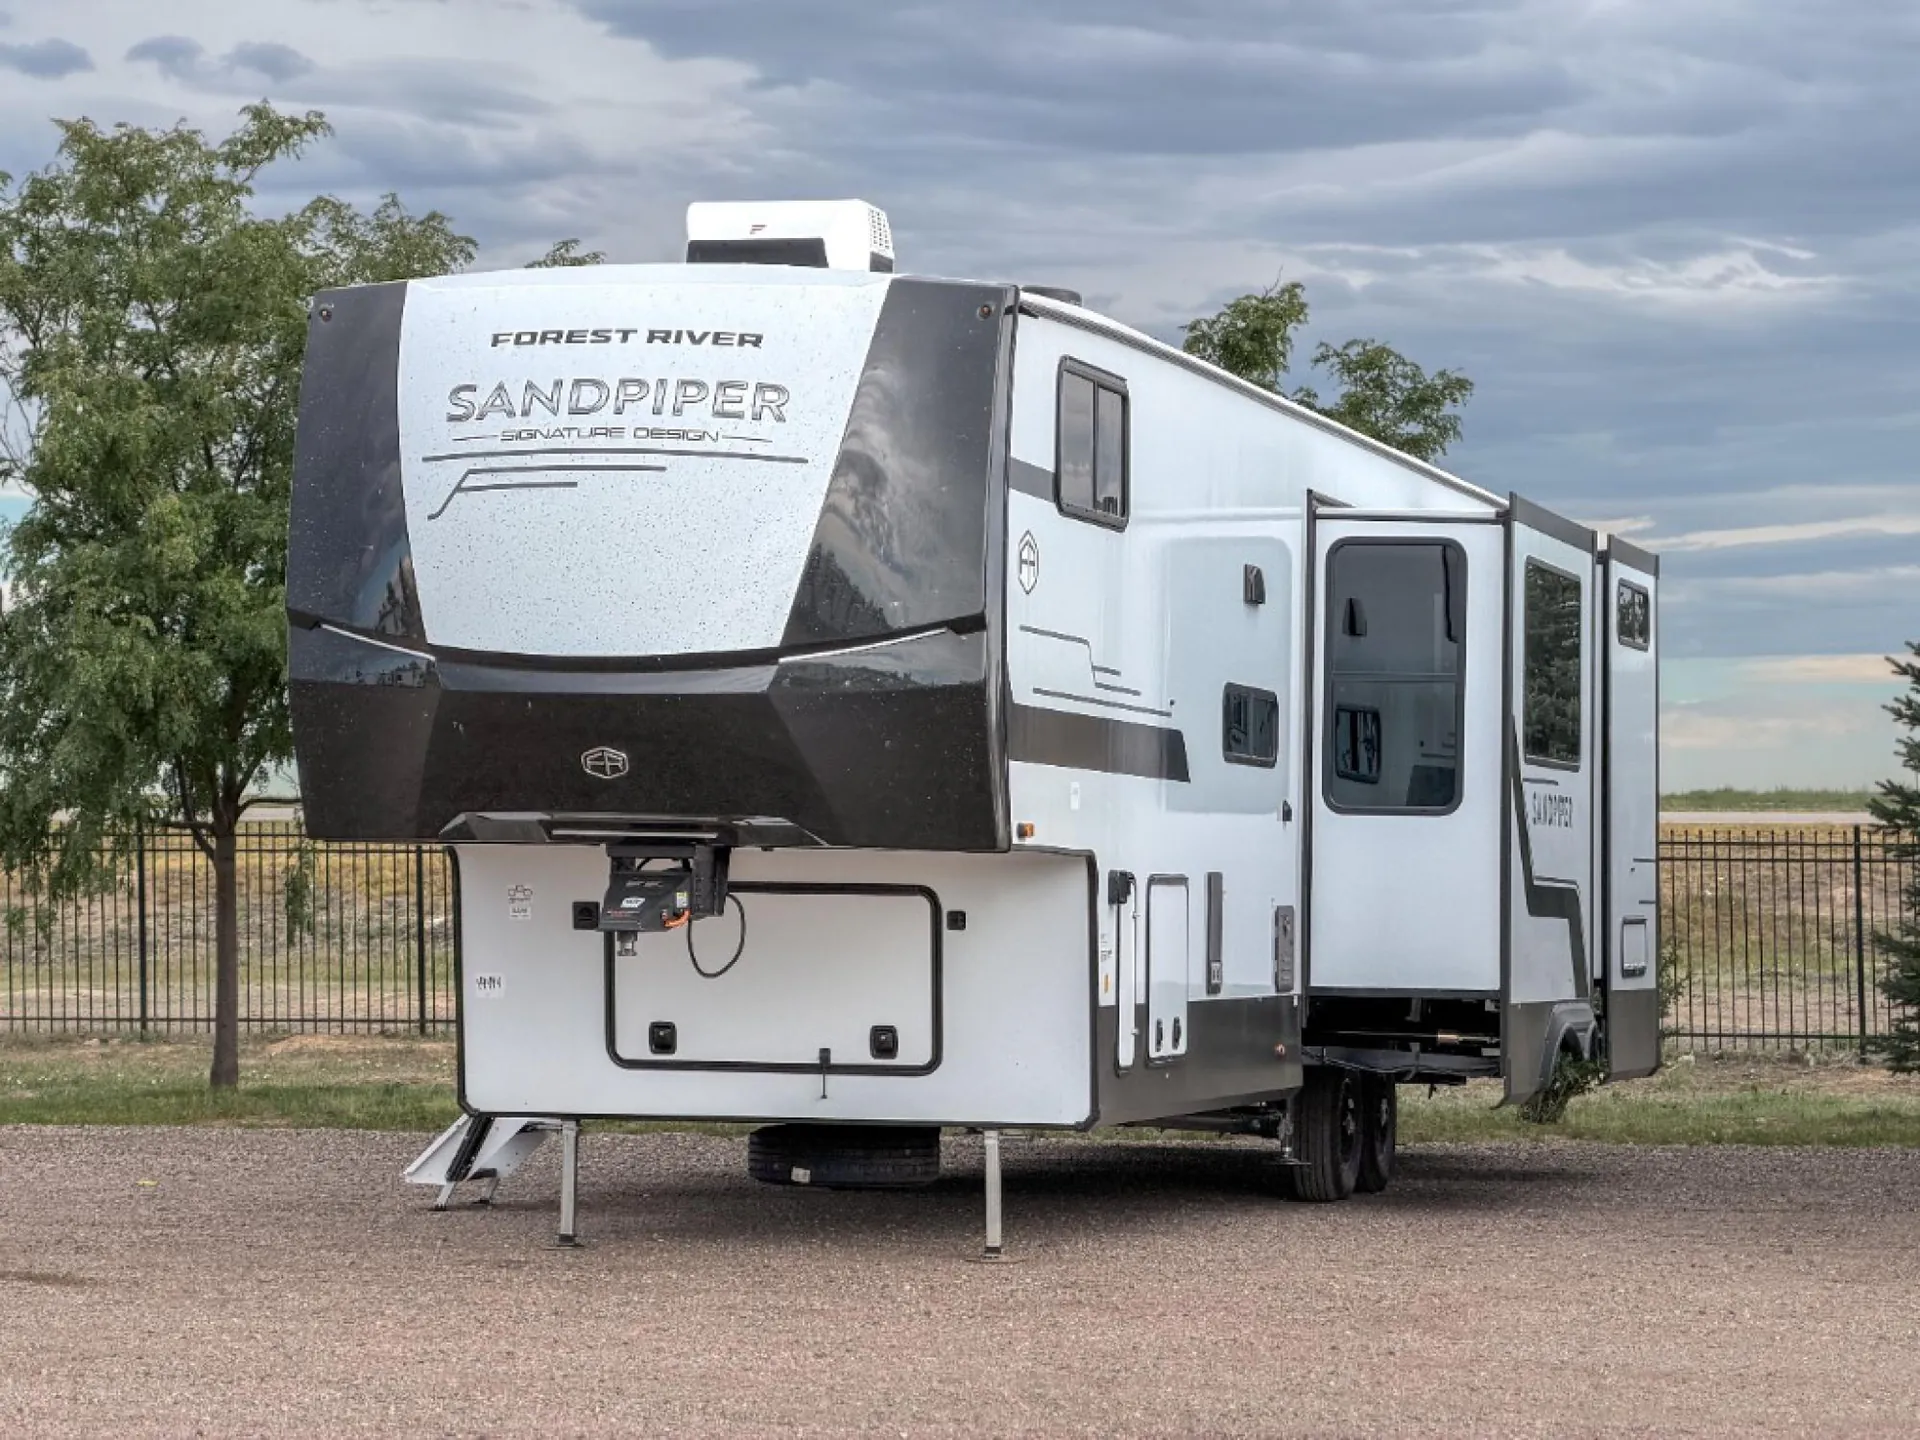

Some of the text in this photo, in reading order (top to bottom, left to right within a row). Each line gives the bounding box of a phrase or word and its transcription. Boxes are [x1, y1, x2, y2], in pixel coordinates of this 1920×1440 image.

[490, 328, 764, 349] FOREST RIVER
[446, 377, 791, 423] SANDPIPER
[500, 426, 720, 442] SIGNATURE DESIGN
